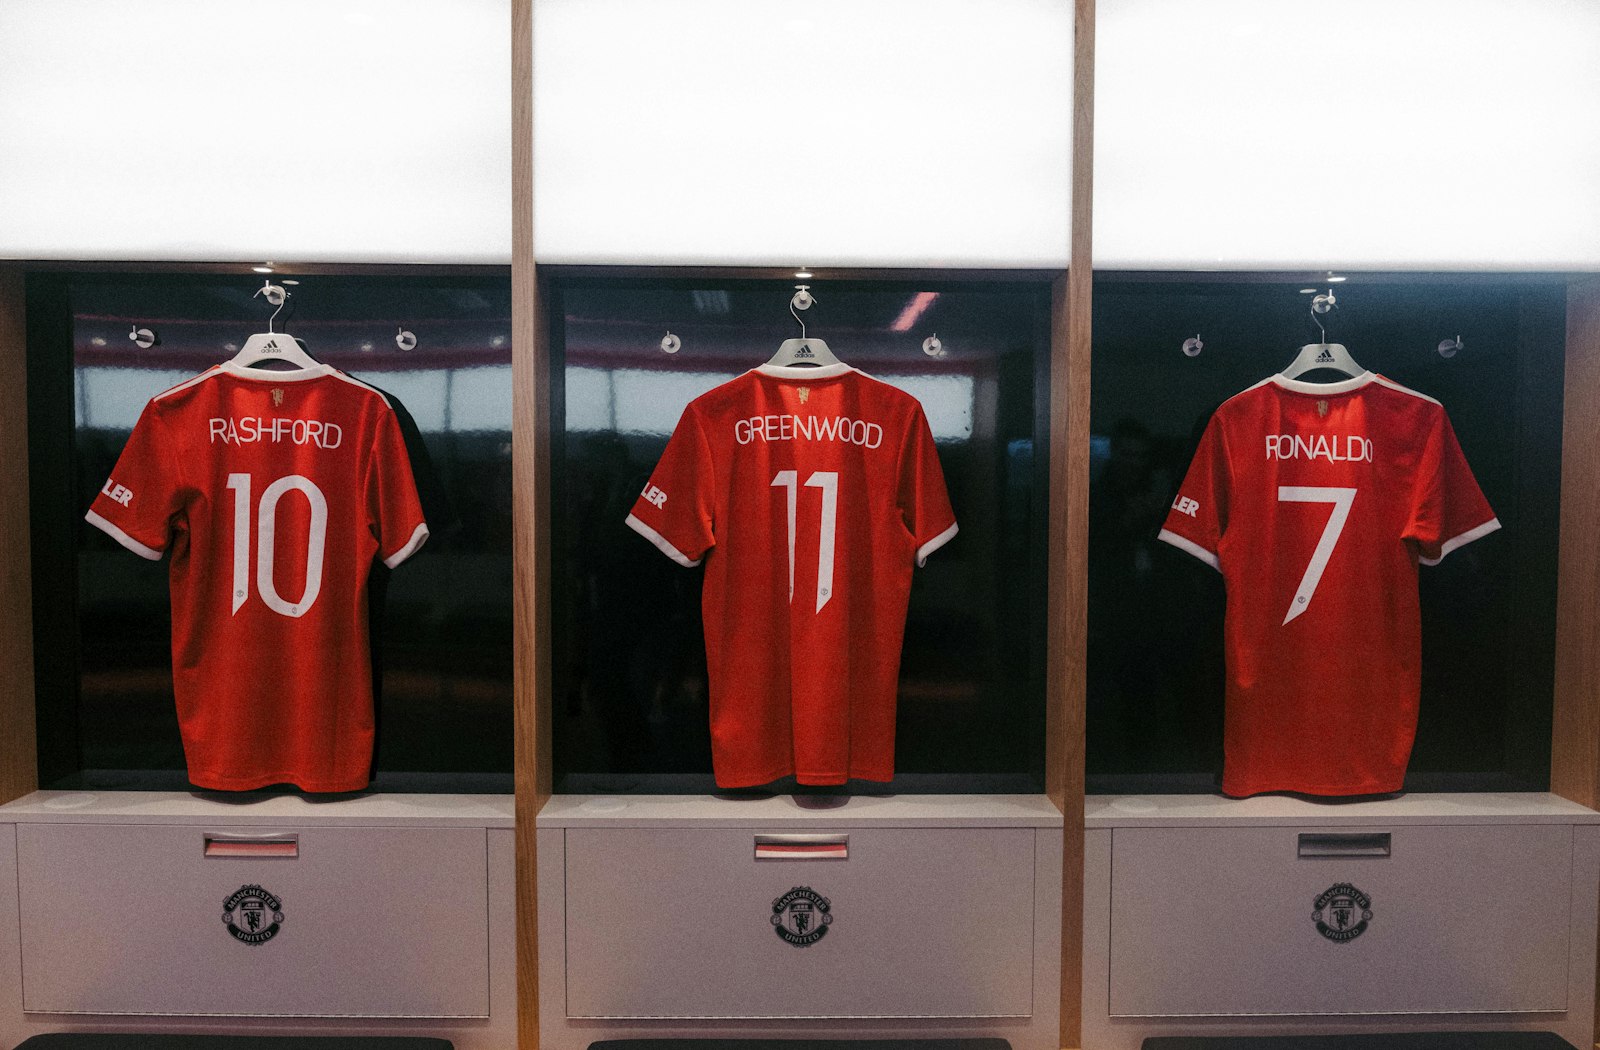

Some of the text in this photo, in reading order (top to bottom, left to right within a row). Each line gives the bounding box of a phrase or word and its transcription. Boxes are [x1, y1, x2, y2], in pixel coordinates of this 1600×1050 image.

[209, 416, 342, 449] RASHFORD
[735, 415, 883, 449] GREENWOOD
[1266, 434, 1373, 464] RONALDO
[226, 473, 329, 618] 10
[770, 470, 838, 615] 11
[1278, 486, 1358, 626] 7
[228, 889, 278, 909] MANCHESTER
[777, 891, 827, 910] MANCHESTER
[1318, 887, 1367, 907] MANCHESTER
[237, 931, 272, 942] UNITED
[785, 933, 819, 943] UNITED
[1325, 928, 1359, 939] UNITED
